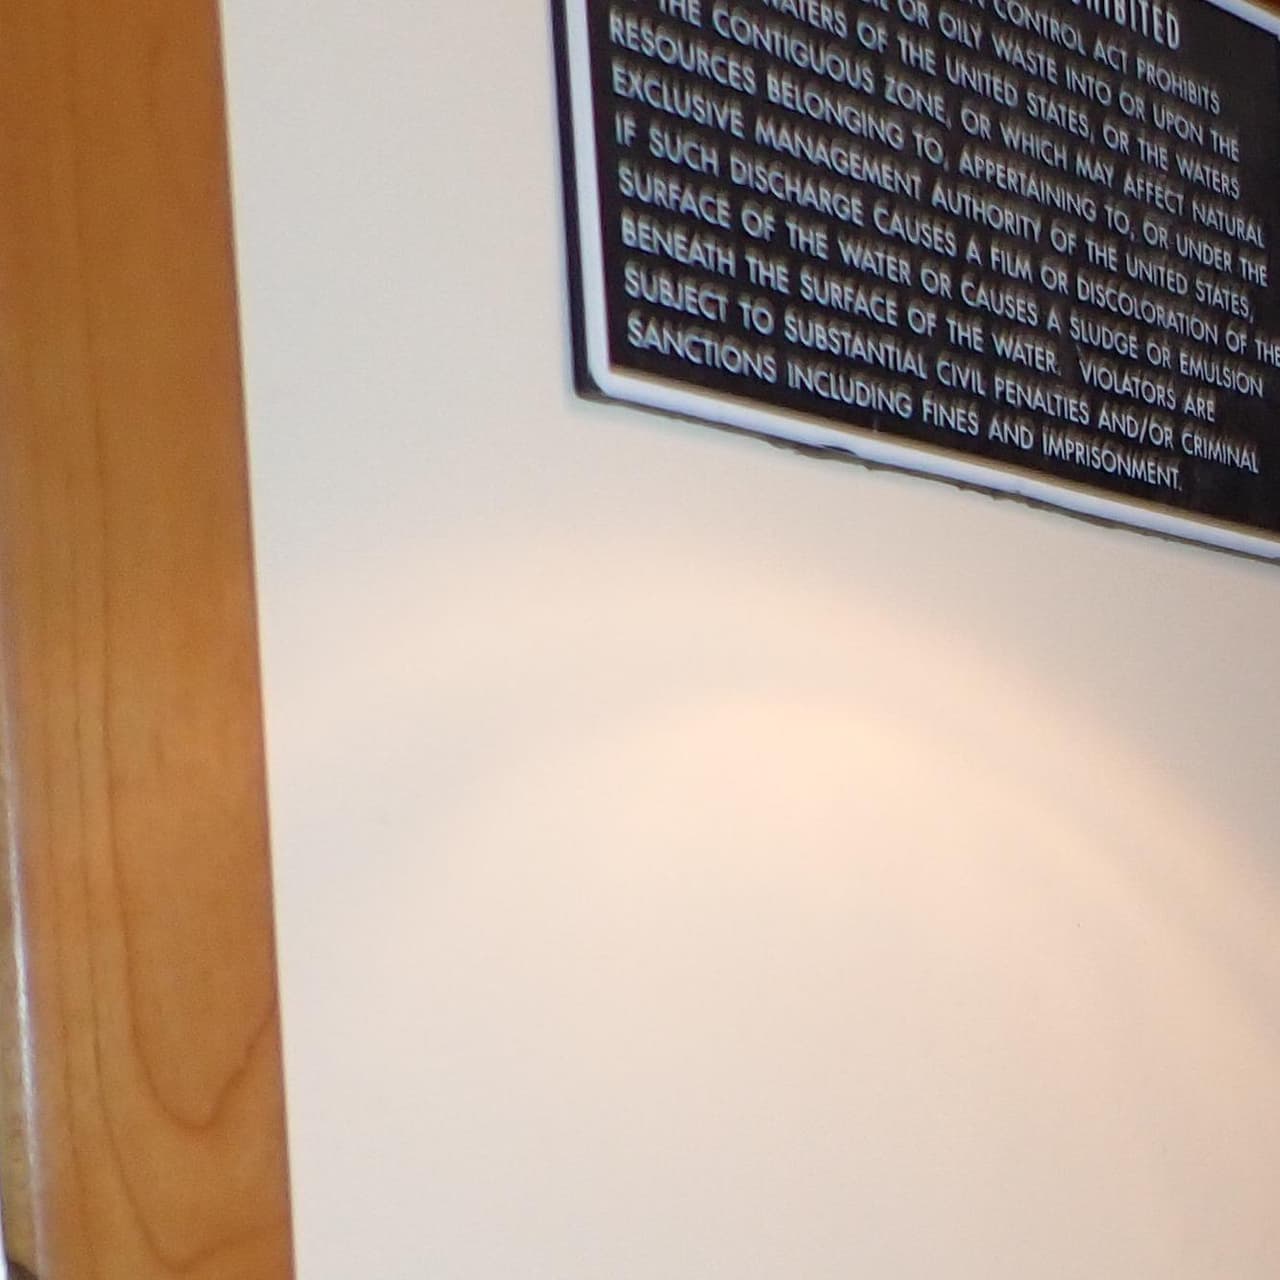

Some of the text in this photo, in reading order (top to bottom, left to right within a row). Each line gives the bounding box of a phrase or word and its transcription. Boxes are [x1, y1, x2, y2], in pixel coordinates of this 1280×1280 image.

[608, 9, 1267, 287] RESOURCES BELONGING TO, APPERTAINING TO, OR UNDER THE
[611, 61, 1253, 322] EXCLUSIVE MANAGEMENT AUTHORITY OF THE UNITED STATES,
[711, 6, 1264, 248] CONTIGUOUS ZONE, OR WHICH MAY AFFECT NATURAL
[856, 19, 1239, 199] OF THE UNITED STATES, OR THE WATERS
[614, 113, 636, 146] IF
[648, 125, 718, 175] SUCH
[729, 153, 864, 226] DISCHARGE
[872, 204, 956, 257] CAUSES
[965, 237, 981, 265] A
[990, 244, 1032, 282] FILM
[1040, 263, 1068, 294] OR
[1076, 274, 1218, 344] DISCOLORATION
[1225, 328, 1247, 354] OF
[617, 164, 1263, 397] SURFACE OF THE WATER OR CAUSES A SLUDGE OR EMULSION
[620, 213, 1215, 422] BENEATH THE SURFACE OF THE WATER. VIOLATORS ARE
[624, 262, 1258, 473] SUBJECT TO SUBSTANTIAL CIVIL PENALTIES AND/OR CRIMINAL
[627, 313, 1182, 490] SANCTIONS INCLUDING FINES AND IMPRISONMENT.
